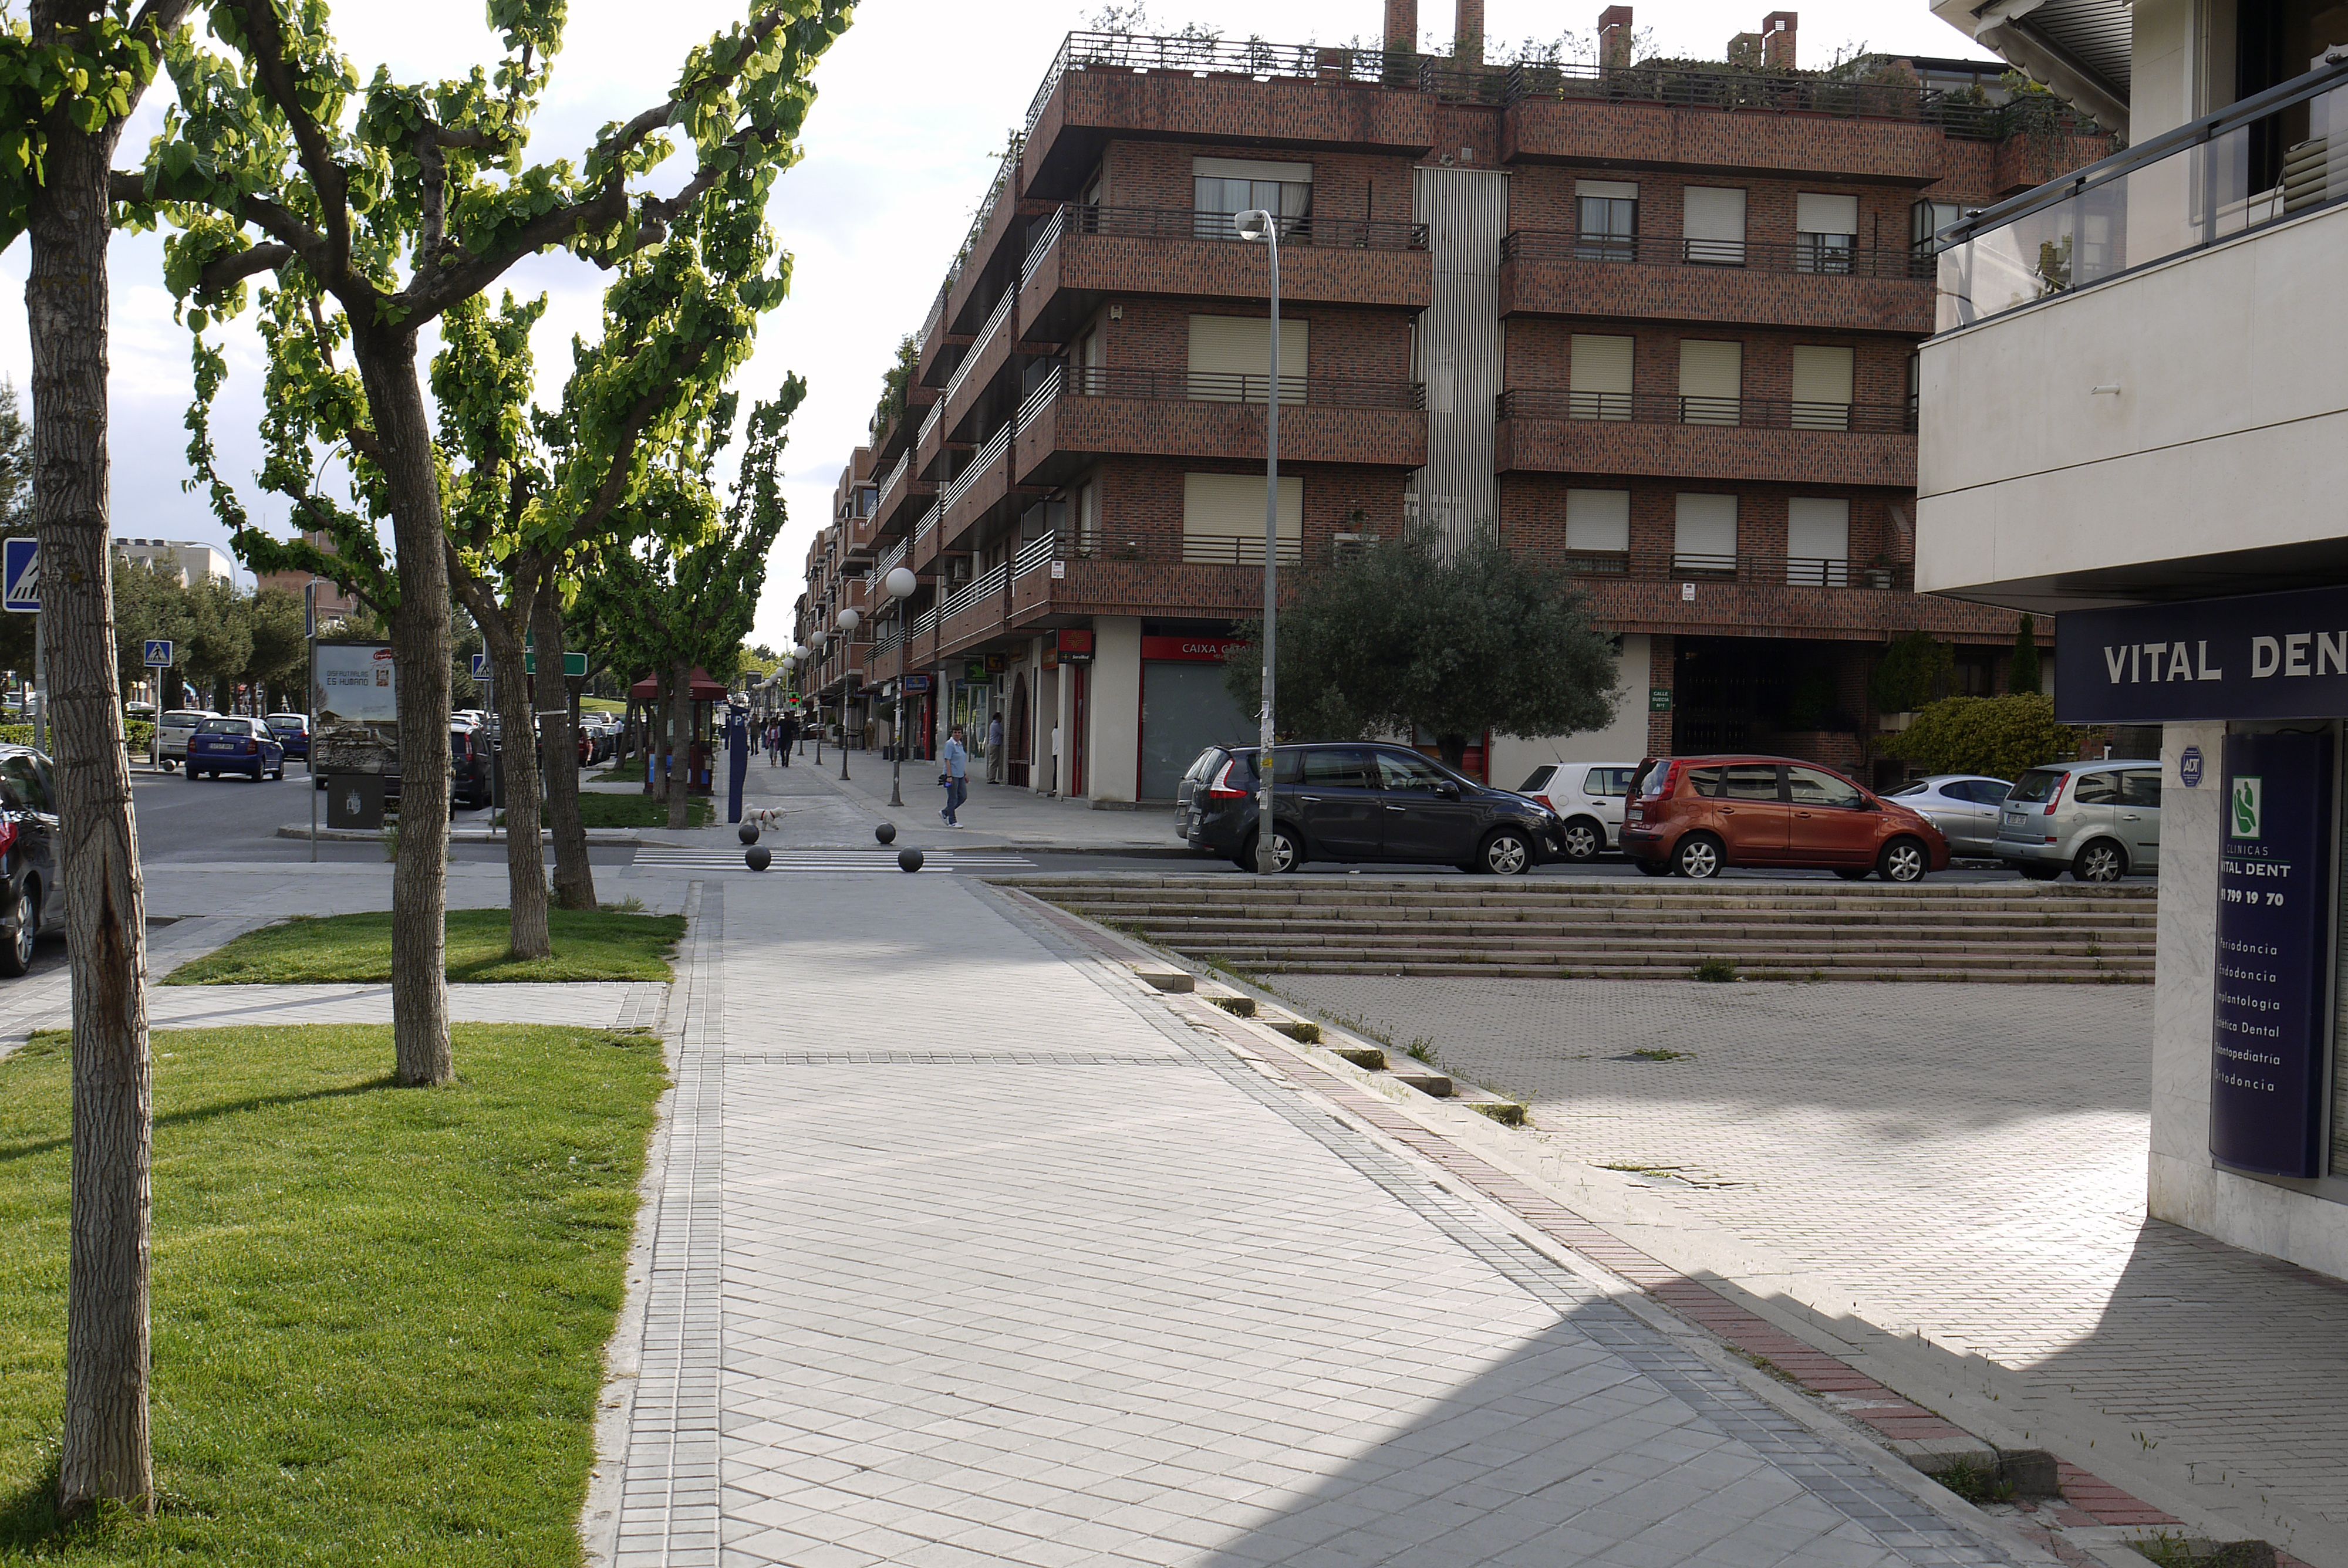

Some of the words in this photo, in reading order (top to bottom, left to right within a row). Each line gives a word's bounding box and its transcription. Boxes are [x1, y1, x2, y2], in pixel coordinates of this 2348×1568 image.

[1182, 643, 1216, 653] CAIXA
[2103, 640, 2222, 684] VITAL
[2251, 630, 2348, 679] DEN
[735, 716, 743, 726] P
[2184, 758, 2200, 773] ADT
[2226, 844, 2269, 856] CLINICAS
[2246, 863, 2292, 877] DENT
[2227, 888, 2242, 903] 799
[2246, 891, 2259, 904] 19
[2266, 893, 2285, 906] 70
[2220, 937, 2278, 955] Periodoncia
[2219, 963, 2276, 983] Endodoncia
[2241, 1022, 2280, 1038] Dental
[2214, 1068, 2275, 1091] Ortodoncia
